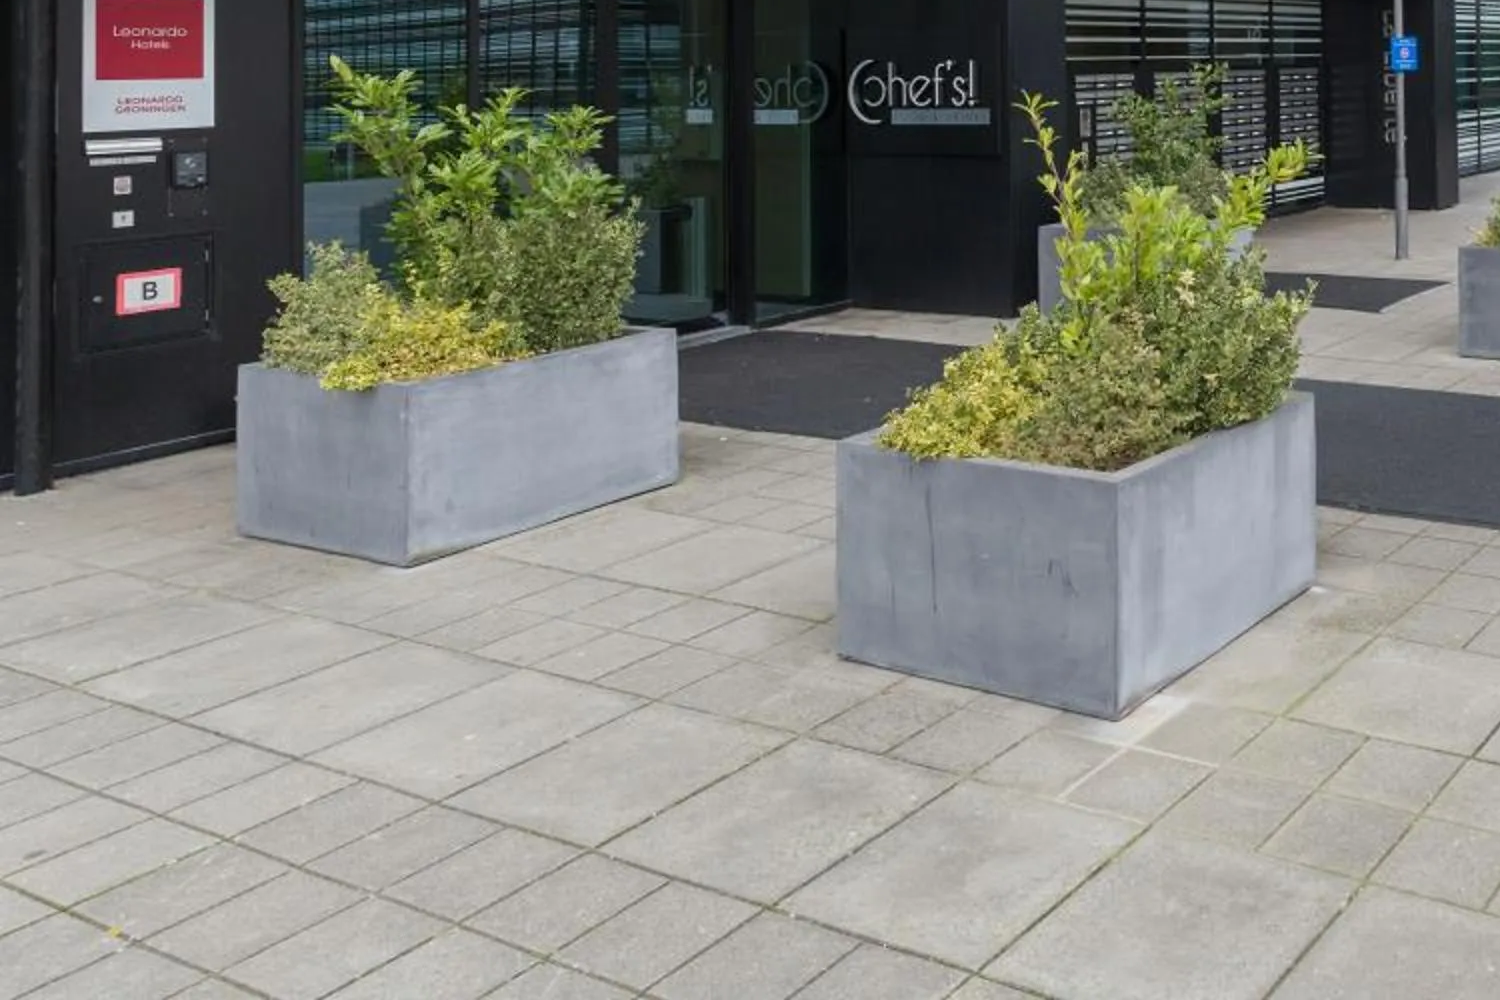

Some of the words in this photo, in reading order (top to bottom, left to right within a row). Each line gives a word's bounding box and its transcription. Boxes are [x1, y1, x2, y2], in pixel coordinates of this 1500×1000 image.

[112, 24, 188, 38] Leonardo
[130, 39, 171, 50] Hotels
[116, 94, 184, 105] LEONARDO
[142, 281, 158, 301] B
